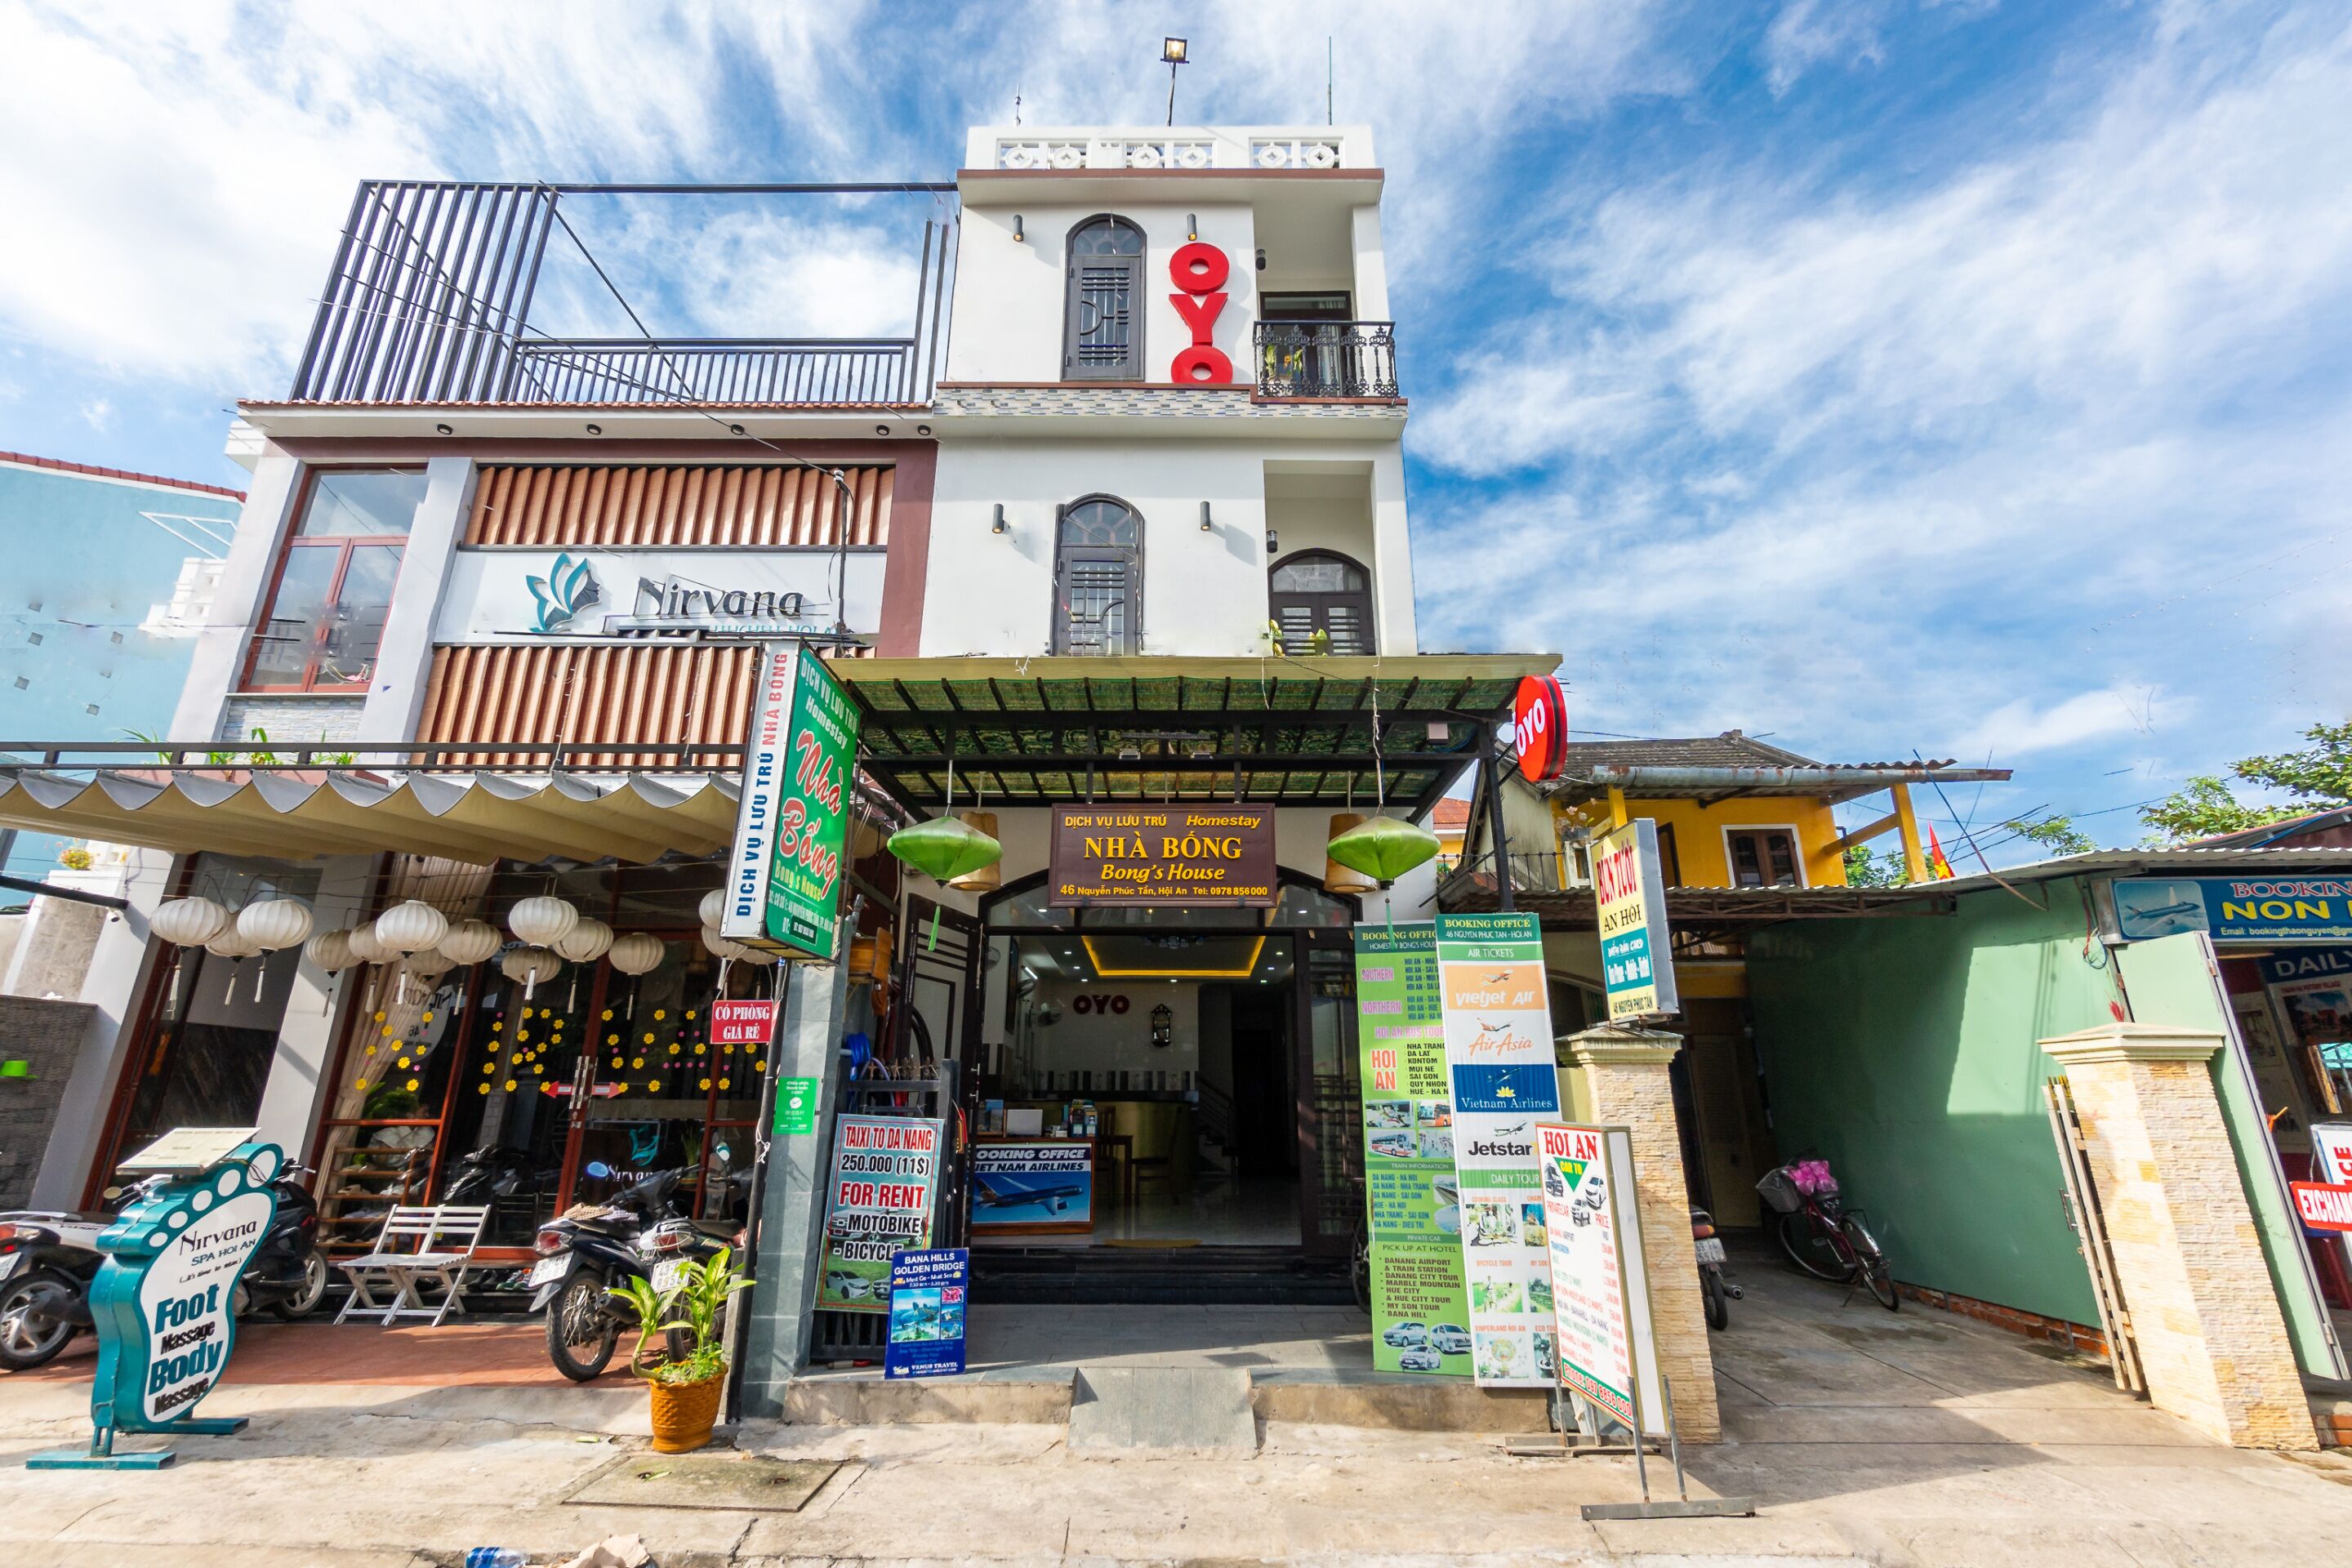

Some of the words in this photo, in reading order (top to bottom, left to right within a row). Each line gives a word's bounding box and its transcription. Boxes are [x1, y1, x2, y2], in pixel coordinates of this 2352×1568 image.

[1169, 242, 1233, 384] OYO
[633, 575, 805, 618] Nirvana
[801, 657, 821, 693] DỊCH
[821, 679, 831, 707] VỤ
[762, 708, 781, 745] NHÀ
[805, 694, 848, 750] Homestay
[1516, 698, 1545, 757] OYO
[795, 729, 842, 816] Nhà
[749, 794, 767, 831] LƯU
[1065, 816, 1092, 830] DỊCH
[1096, 816, 1112, 830] VỤ
[1116, 814, 1139, 826] LƯU
[1143, 814, 1167, 827] TRÚ
[1186, 815, 1261, 829] Homestay
[745, 836, 760, 862] VỤ
[1084, 831, 1148, 859] NHÀ
[1161, 831, 1242, 859] BỐNG
[1101, 863, 1163, 884] Bong's
[1168, 863, 1225, 880] House
[737, 868, 757, 916] DỊCH
[801, 875, 822, 902] House
[1060, 884, 1075, 896] 46
[1077, 884, 1111, 897] Nguyễn
[1113, 884, 1135, 896] Phúc
[1158, 886, 1174, 898] Hội
[1176, 887, 1187, 895] An
[1192, 887, 1209, 895] Tel:
[2222, 901, 2331, 920] NON
[1445, 920, 1491, 928] BOOKING
[1494, 920, 1531, 928] OFFICE
[1604, 912, 1618, 933] AN
[1362, 930, 1407, 941] BOOKNG
[1468, 948, 1481, 957] AIR
[1482, 948, 1514, 957] TICKETS
[1361, 969, 1394, 981] SOUTHERN
[1073, 995, 1130, 1014] OYO
[1361, 1001, 1401, 1013] NORTHERN
[1512, 991, 1535, 1005] Air
[715, 1004, 730, 1020] CÓ
[733, 1004, 770, 1020] PHÒNG
[723, 1023, 742, 1040] GIÁ
[1375, 1027, 1388, 1038] HOI
[1392, 1027, 1403, 1038] AN
[1405, 1027, 1422, 1038] BUS
[1469, 1032, 1495, 1056] Air
[1495, 1032, 1534, 1056] Asia
[1372, 1049, 1396, 1069] HOI
[1375, 1071, 1396, 1090] AN
[1461, 1097, 1507, 1109] Vietnam
[1510, 1097, 1552, 1109] Airlines
[845, 1125, 871, 1148] TAIXI
[873, 1127, 885, 1149] TO
[888, 1128, 901, 1150] DA
[902, 1129, 933, 1152] NANG
[1468, 1141, 1533, 1156] Jetstar
[1544, 1131, 1570, 1156] HOI
[1575, 1134, 1597, 1160] AN
[976, 1150, 1036, 1160] OOKING
[1039, 1149, 1085, 1159] OFFICE
[841, 1154, 893, 1174] 250.000
[896, 1156, 931, 1177] (11$)
[996, 1163, 1026, 1171] NAM
[1031, 1162, 1085, 1172] AIRLINES
[1560, 1160, 1573, 1174] CAR
[1574, 1162, 1583, 1175] TO
[1490, 1174, 1513, 1184] DAILY
[839, 1182, 875, 1207] FOR
[877, 1185, 926, 1209] RENT
[847, 1214, 921, 1236] MOTOBIKE
[180, 1221, 256, 1255] Nirvana
[191, 1252, 215, 1266] SPA
[219, 1245, 238, 1258] HOI
[240, 1239, 256, 1250] AN
[905, 1254, 929, 1264] BANA
[931, 1253, 955, 1262] HILLS
[894, 1265, 930, 1275] GOLDEN
[933, 1262, 964, 1272] BRIDGE
[154, 1283, 220, 1334] Foot
[161, 1321, 216, 1355] Massage
[149, 1340, 224, 1396] Body
[154, 1378, 209, 1416] Massage
